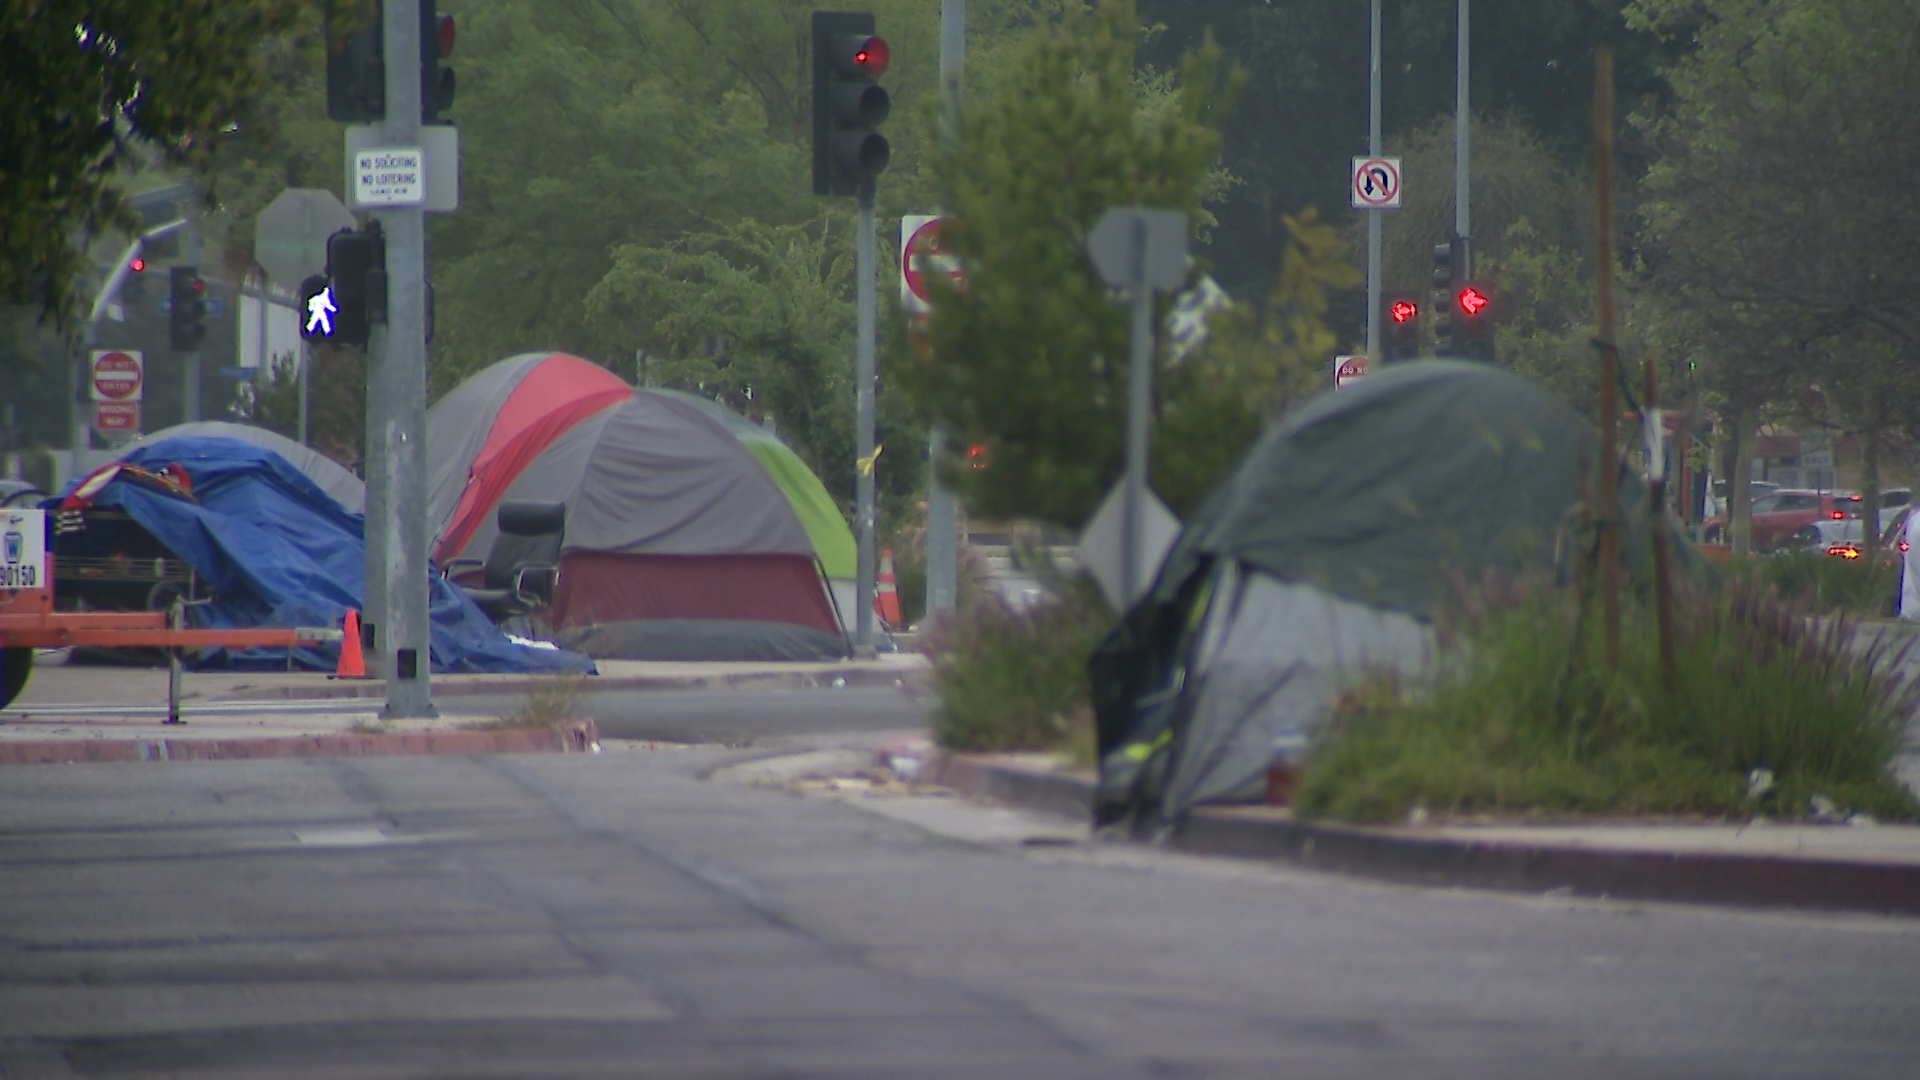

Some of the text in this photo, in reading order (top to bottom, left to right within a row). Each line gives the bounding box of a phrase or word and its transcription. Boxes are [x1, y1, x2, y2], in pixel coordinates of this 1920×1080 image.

[361, 157, 417, 169] NO SOLICITING
[362, 173, 416, 185] NO LOITERING
[99, 405, 135, 414] WRONG
